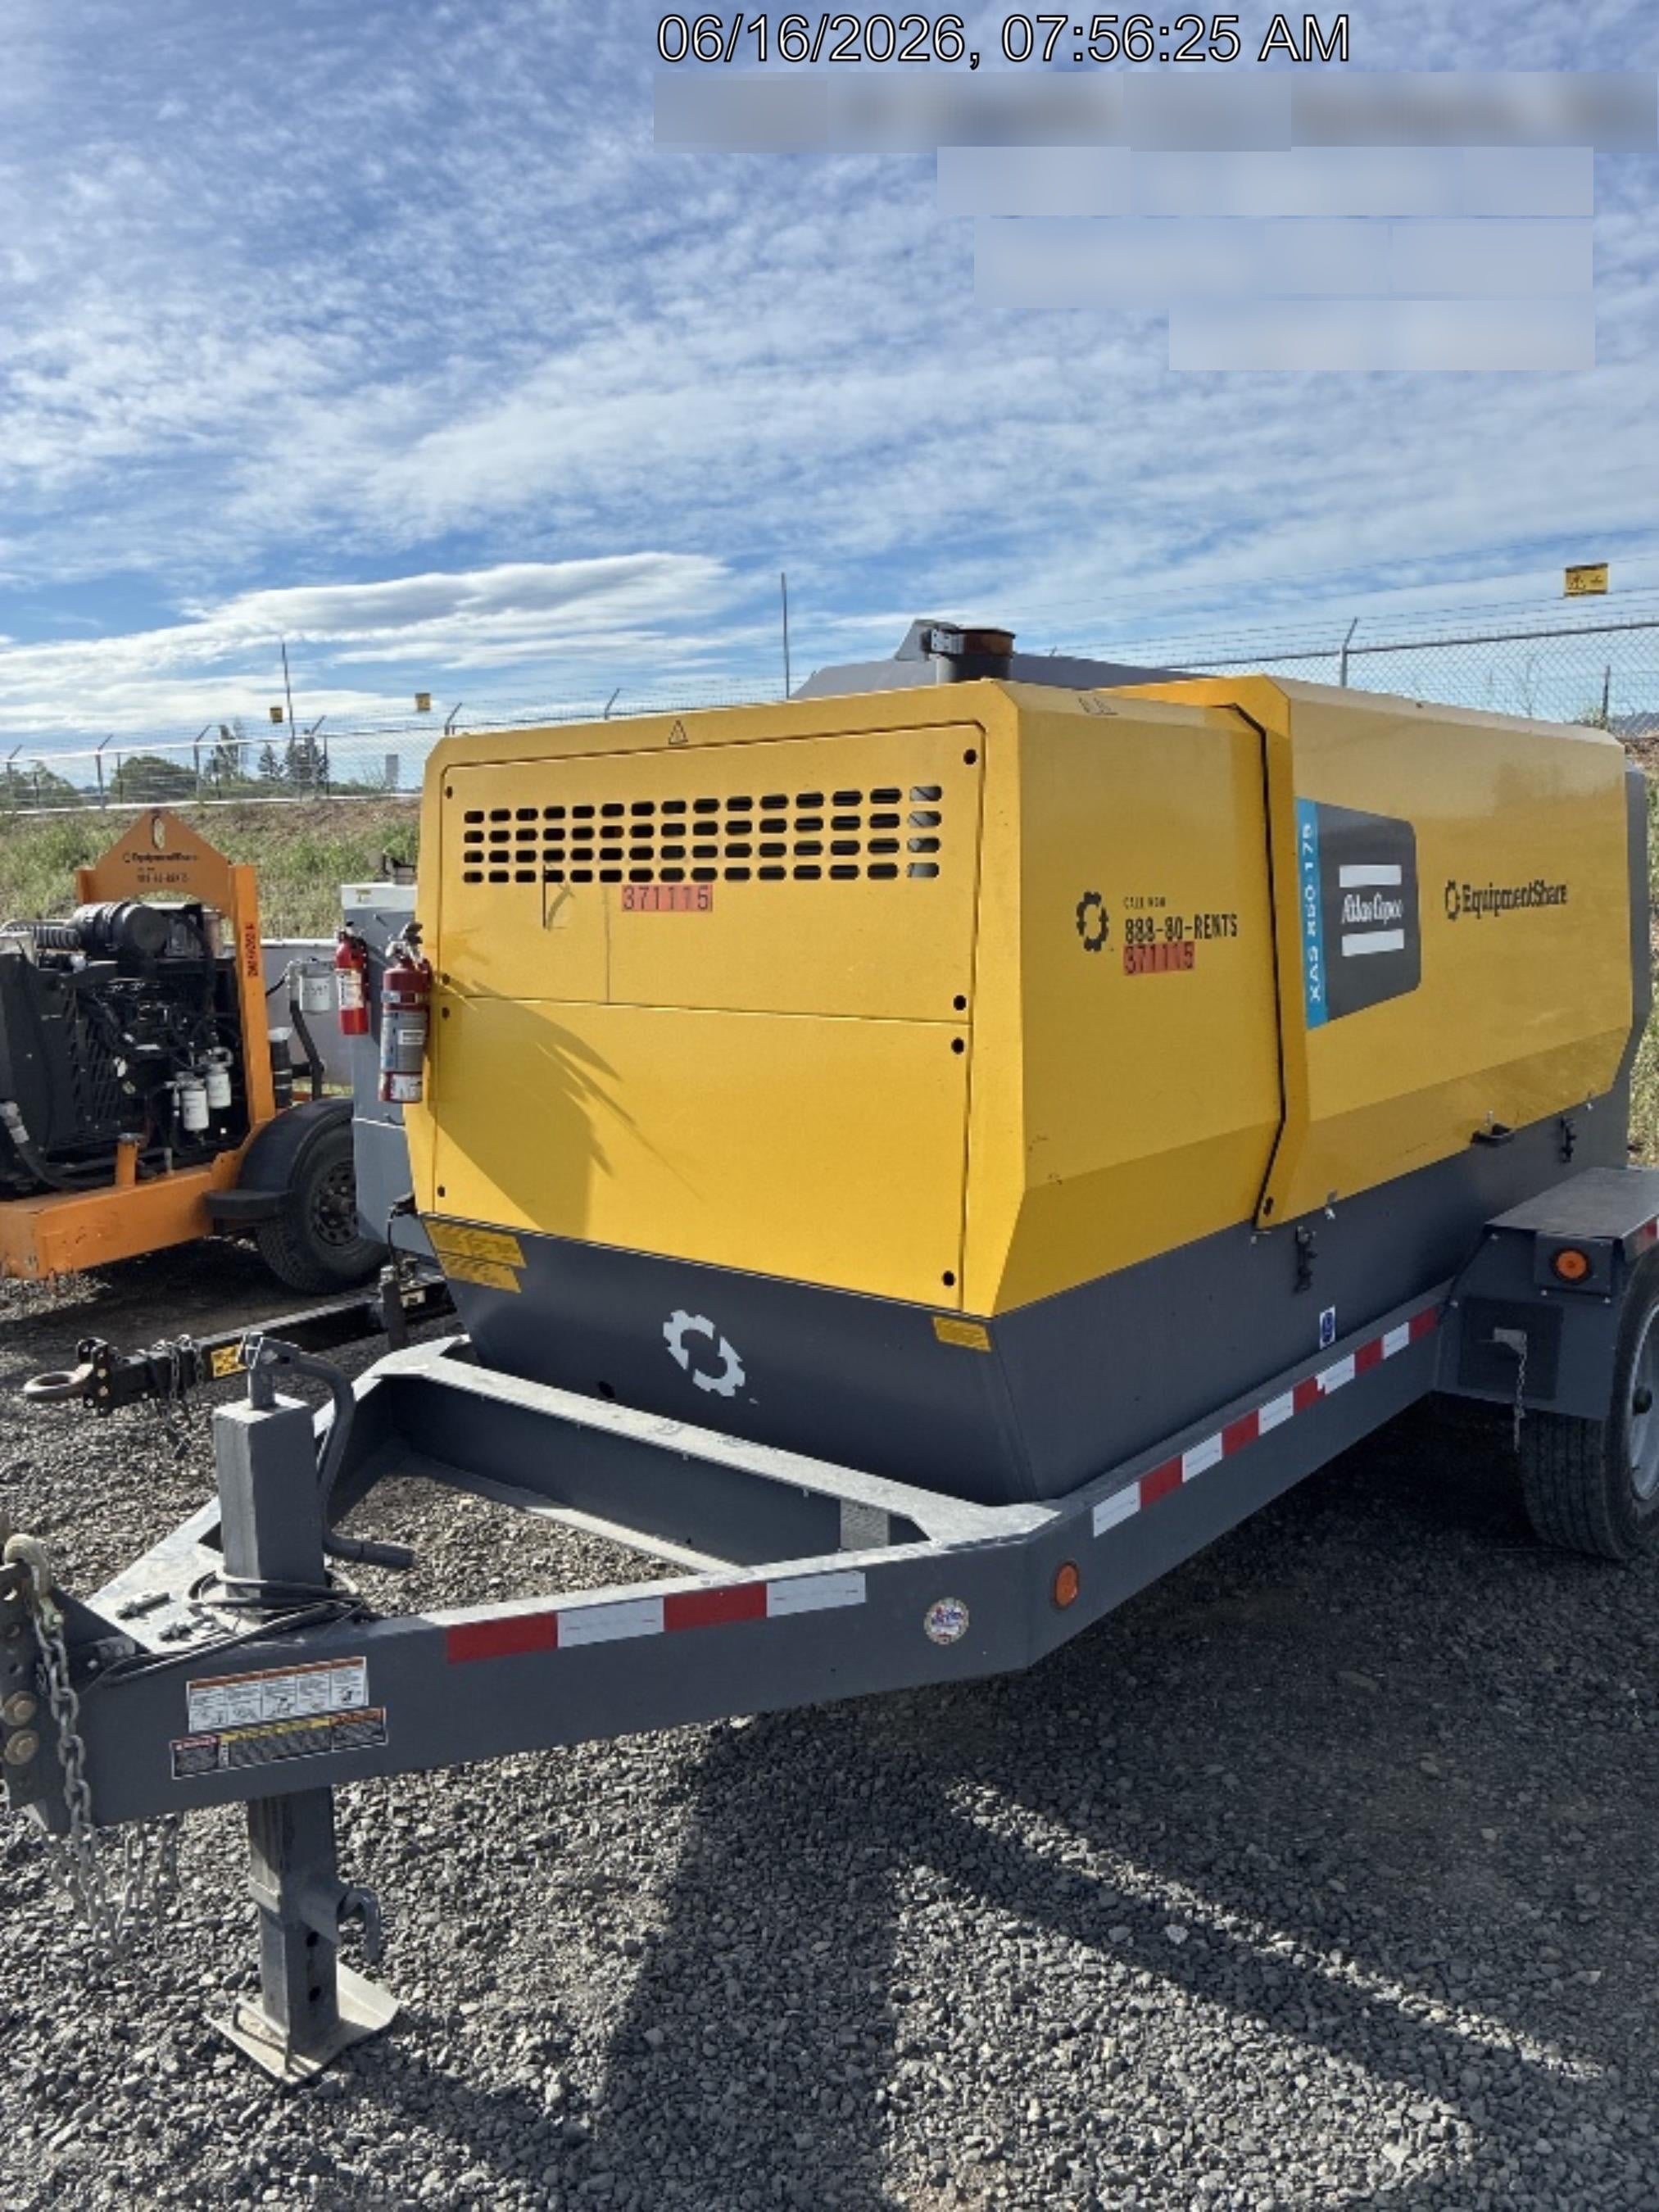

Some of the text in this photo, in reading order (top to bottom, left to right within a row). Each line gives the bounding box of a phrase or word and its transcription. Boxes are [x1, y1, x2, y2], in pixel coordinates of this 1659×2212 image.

[623, 885, 709, 910] 371115
[1341, 891, 1403, 925] Atlas Copco
[1462, 879, 1568, 919] EquipmentShare
[1125, 913, 1238, 945] 888-80-RENTS
[1125, 942, 1194, 975] 371115
[1308, 945, 1321, 1001] XAS
